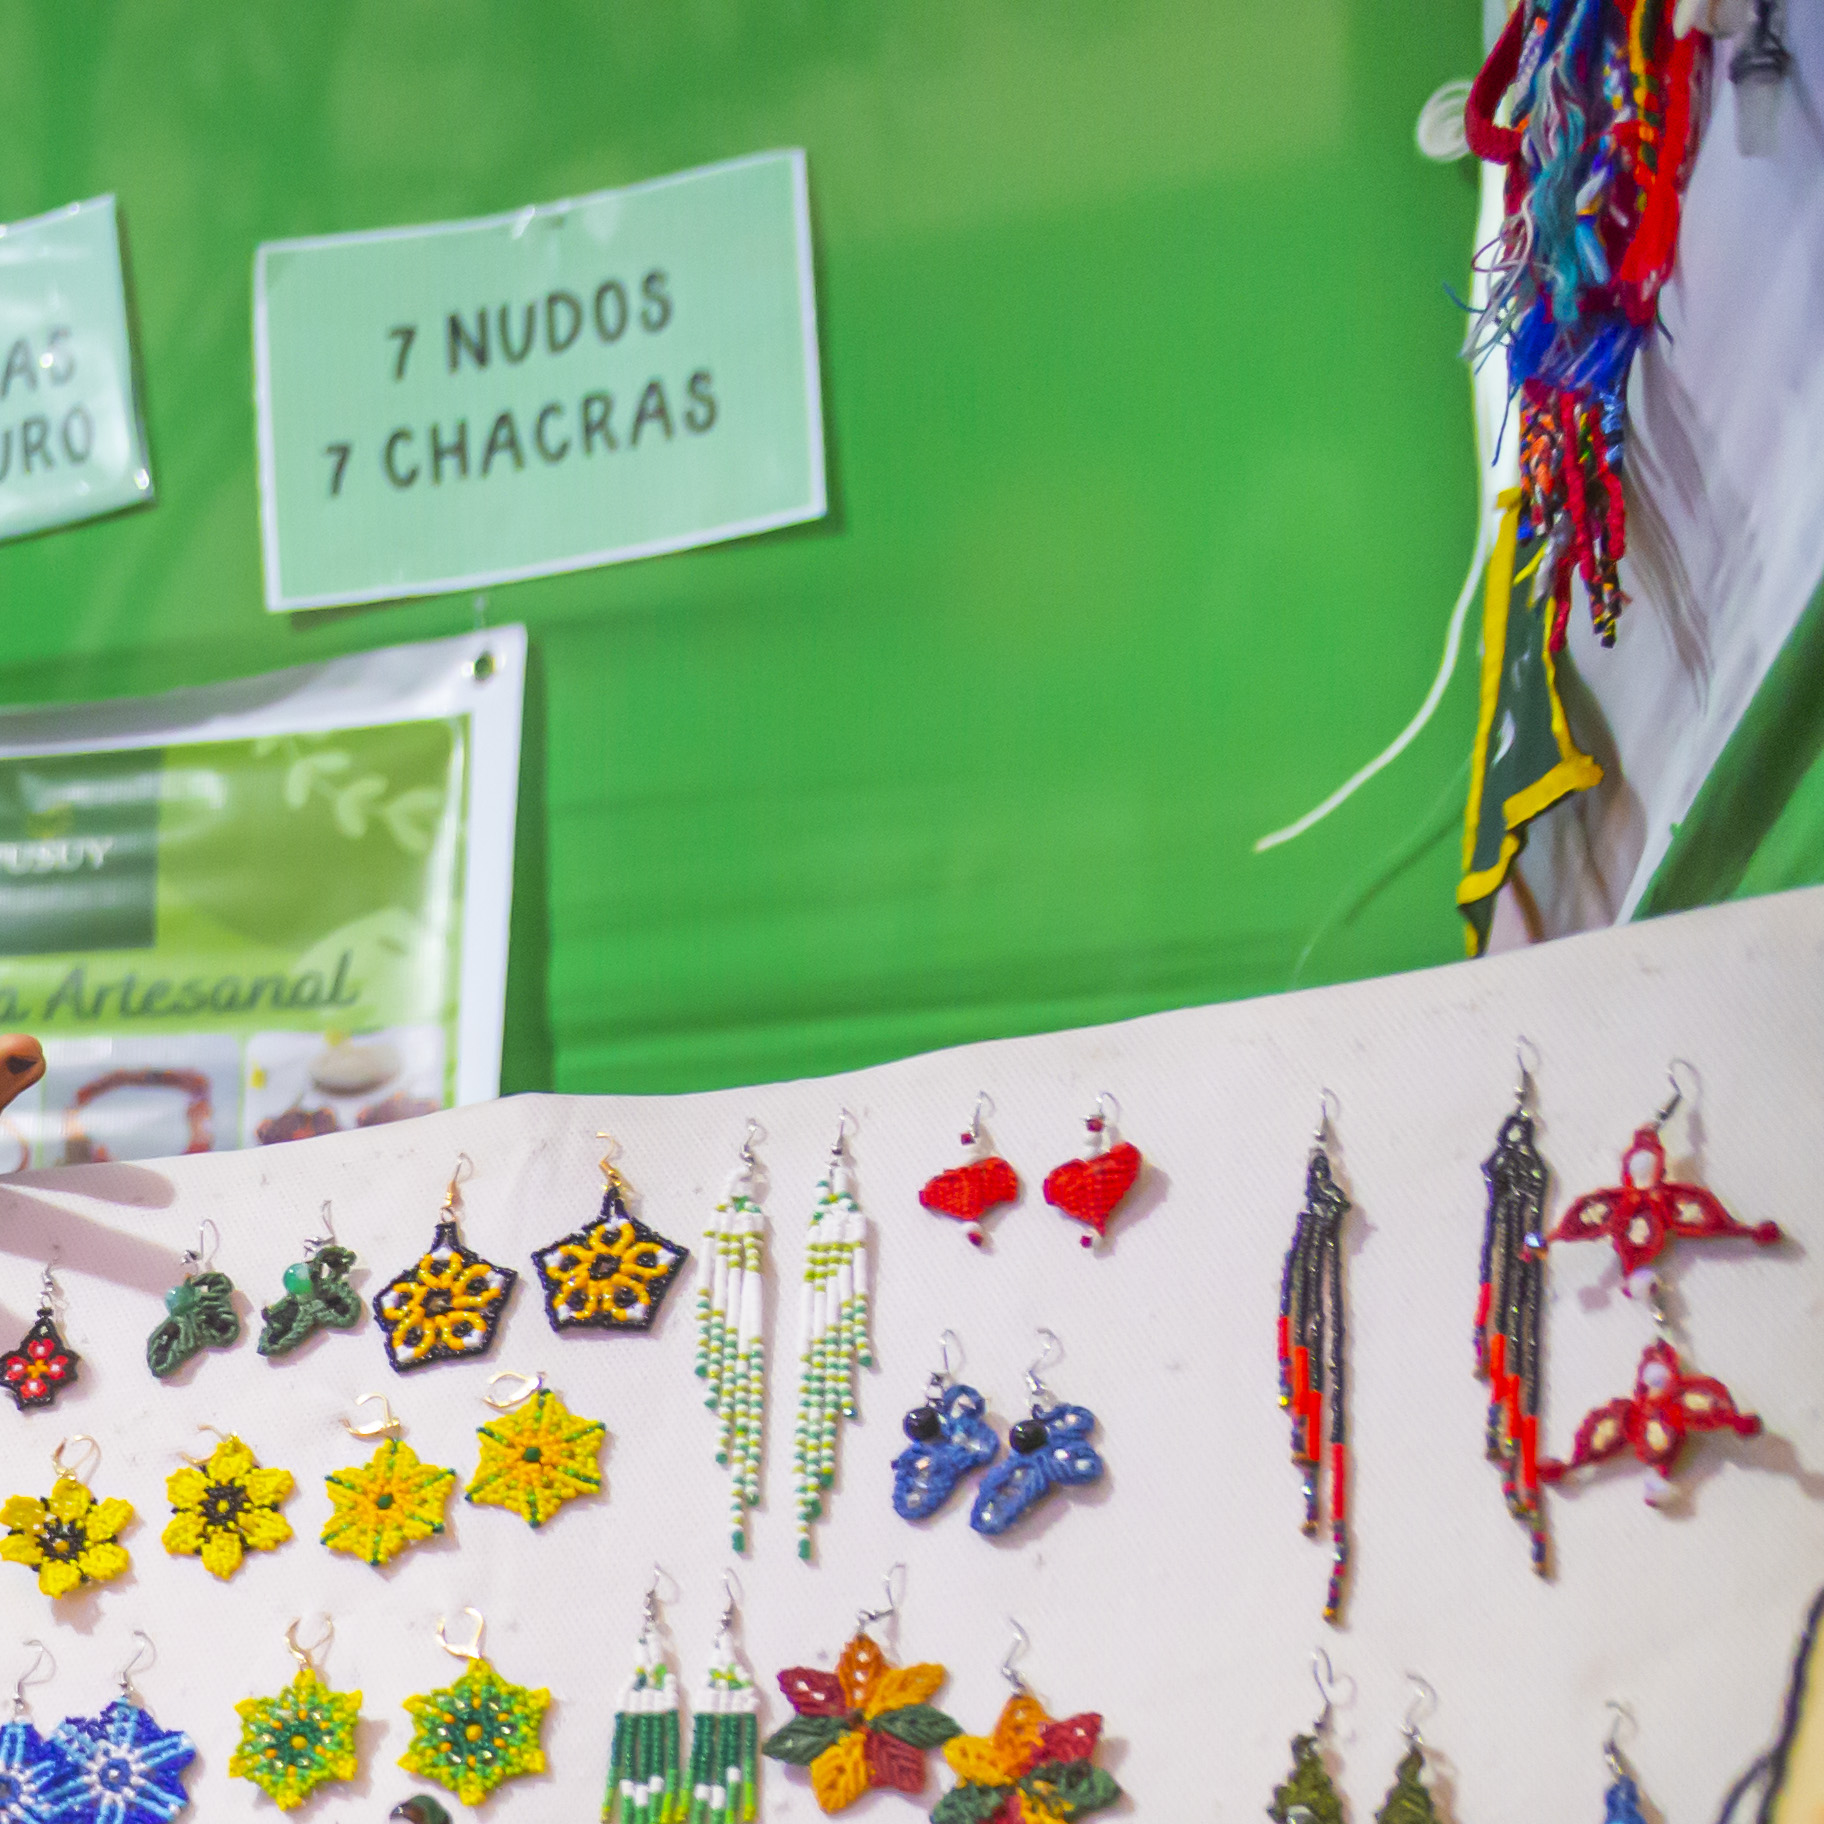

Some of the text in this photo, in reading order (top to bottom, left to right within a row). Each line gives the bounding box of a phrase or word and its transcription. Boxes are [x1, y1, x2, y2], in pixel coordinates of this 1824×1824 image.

[388, 269, 676, 382] 7 NUDOS
[322, 369, 720, 499] 7 CHACRAS
[54, 952, 363, 1024] Artesanal
